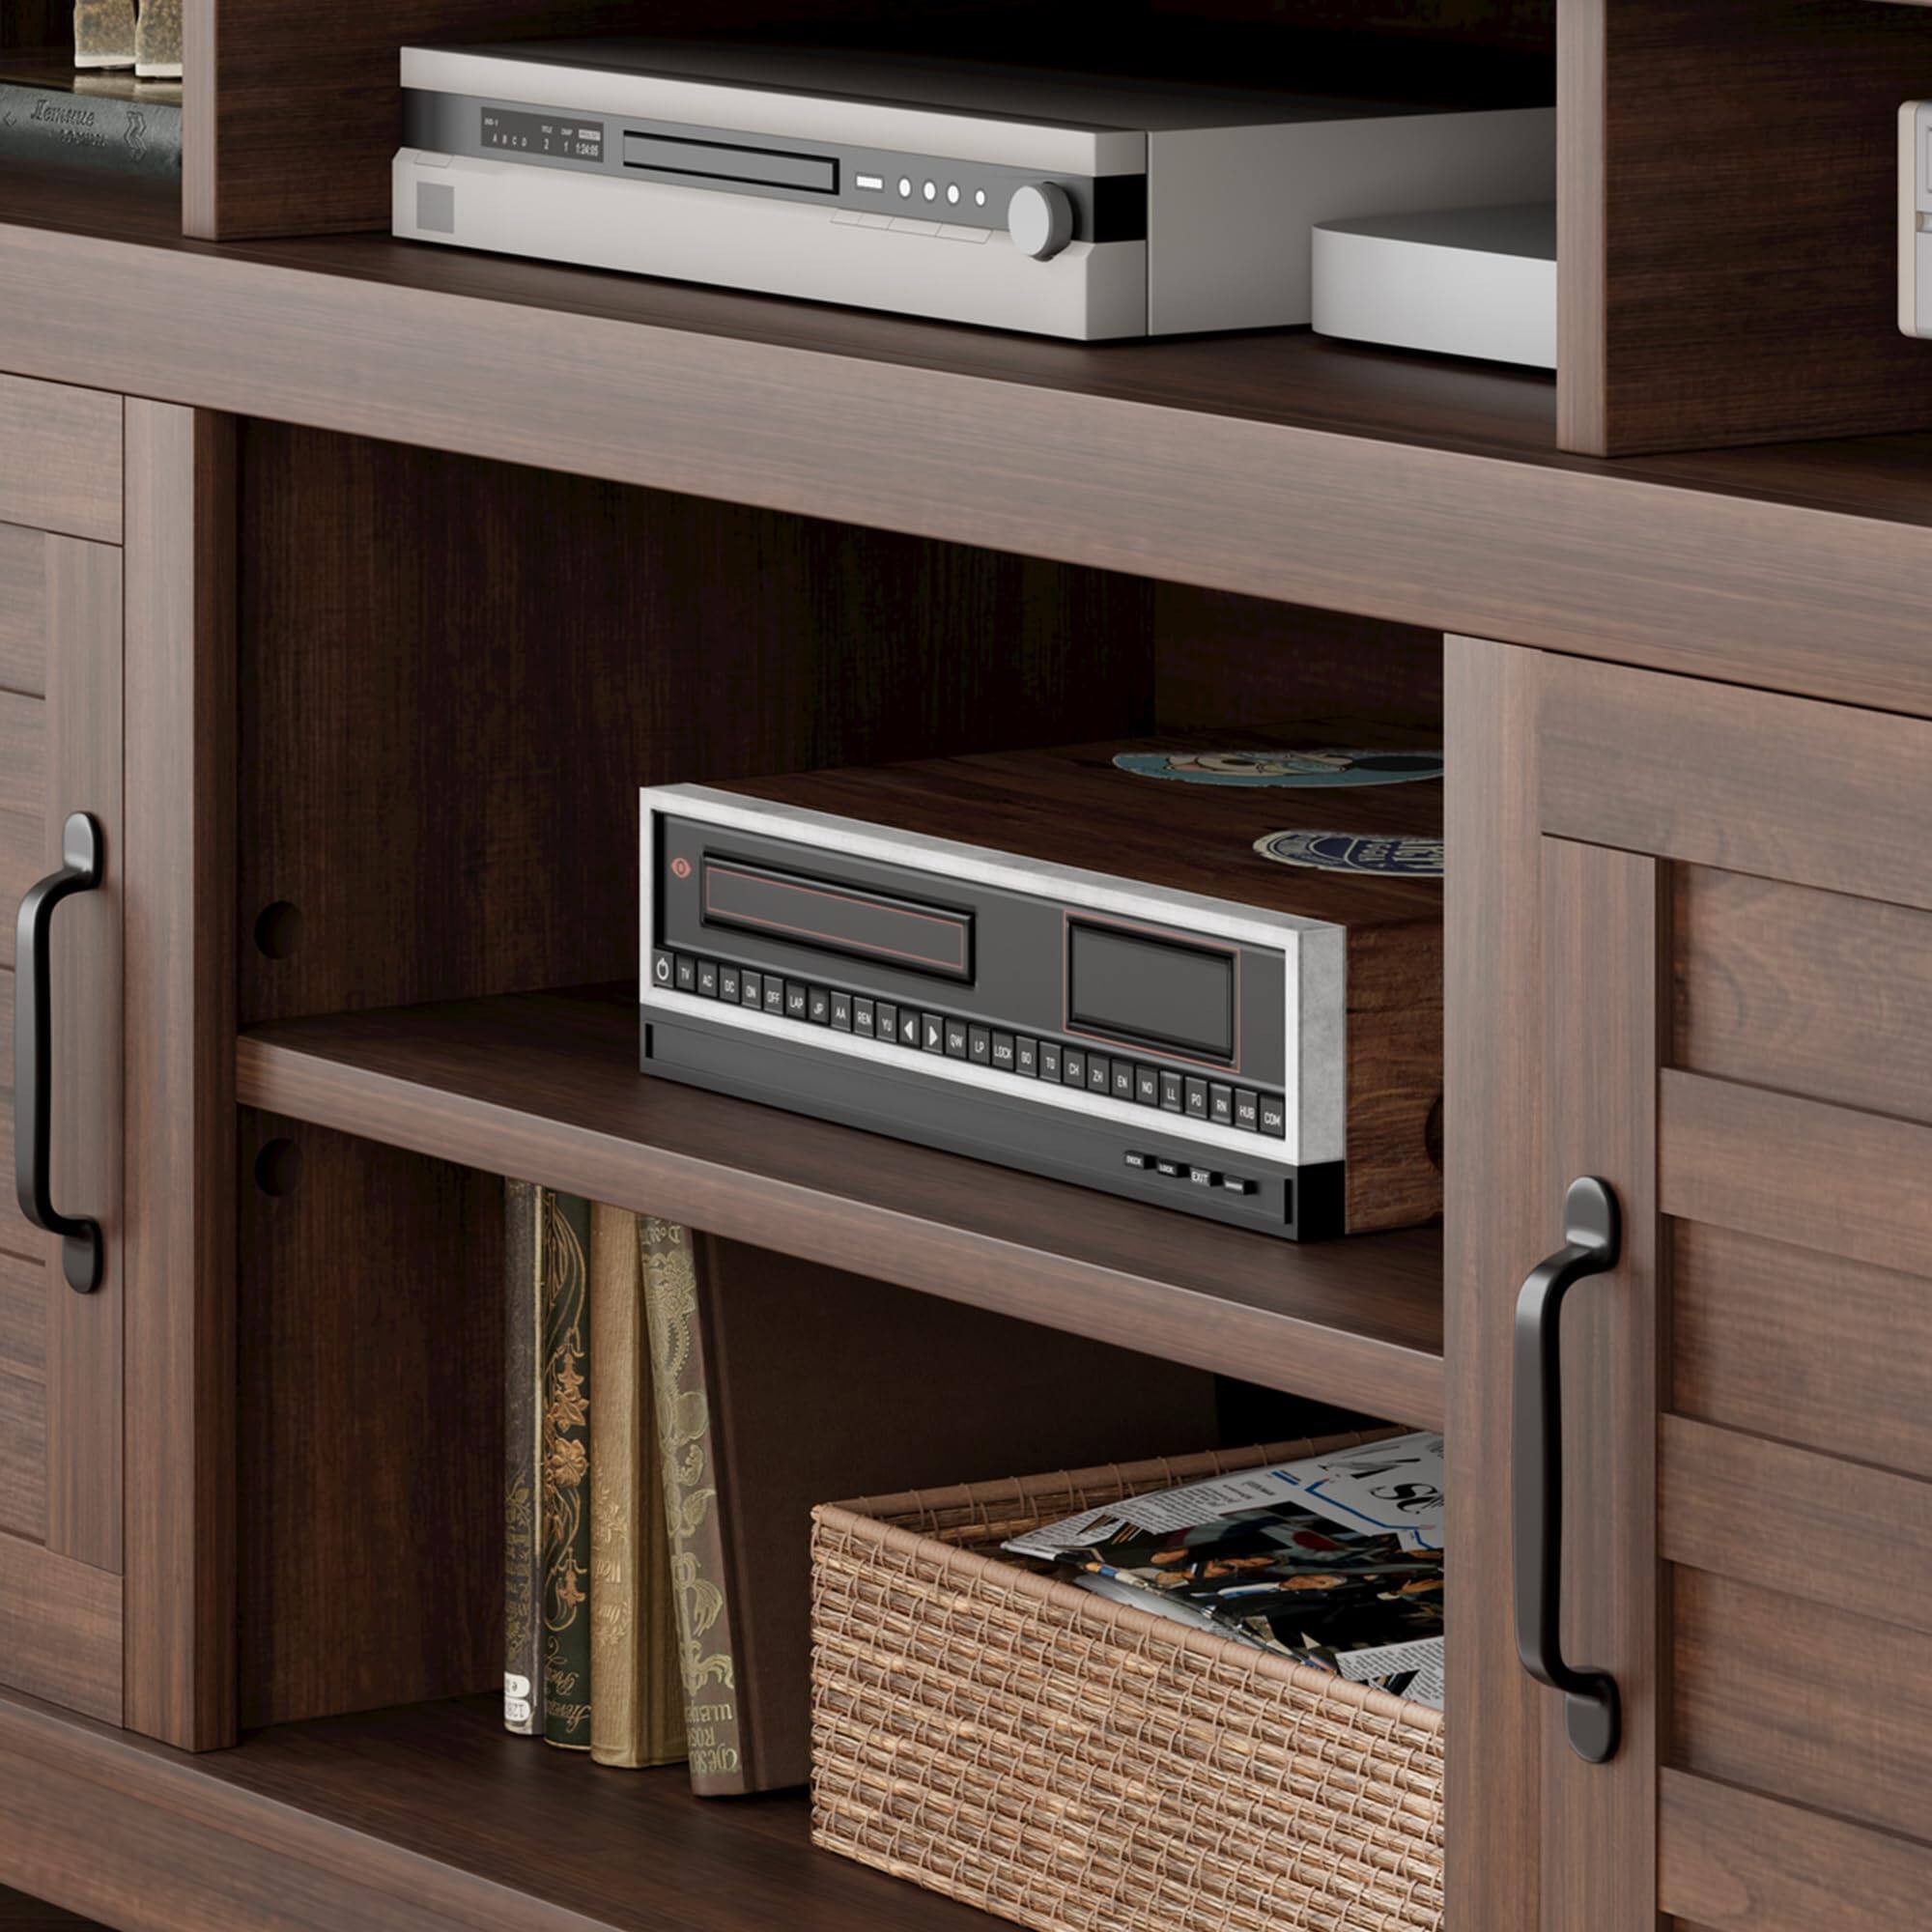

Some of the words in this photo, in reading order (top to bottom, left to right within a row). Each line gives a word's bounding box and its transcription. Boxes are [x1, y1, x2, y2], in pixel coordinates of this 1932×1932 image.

[512, 135, 517, 145] C
[544, 138, 549, 151] 2
[702, 975, 712, 987] AC
[724, 980, 735, 993] DC
[766, 990, 781, 1004] OFF
[789, 996, 804, 1009] LAP
[975, 1040, 984, 1054] LP
[994, 1045, 1012, 1060] LOCK
[1068, 1063, 1080, 1075] CH
[1117, 1074, 1127, 1088] EN
[1166, 1088, 1176, 1101] LL
[1238, 1105, 1255, 1120] HUB
[1264, 1112, 1281, 1126] COM
[1191, 1171, 1208, 1183] EXIT
